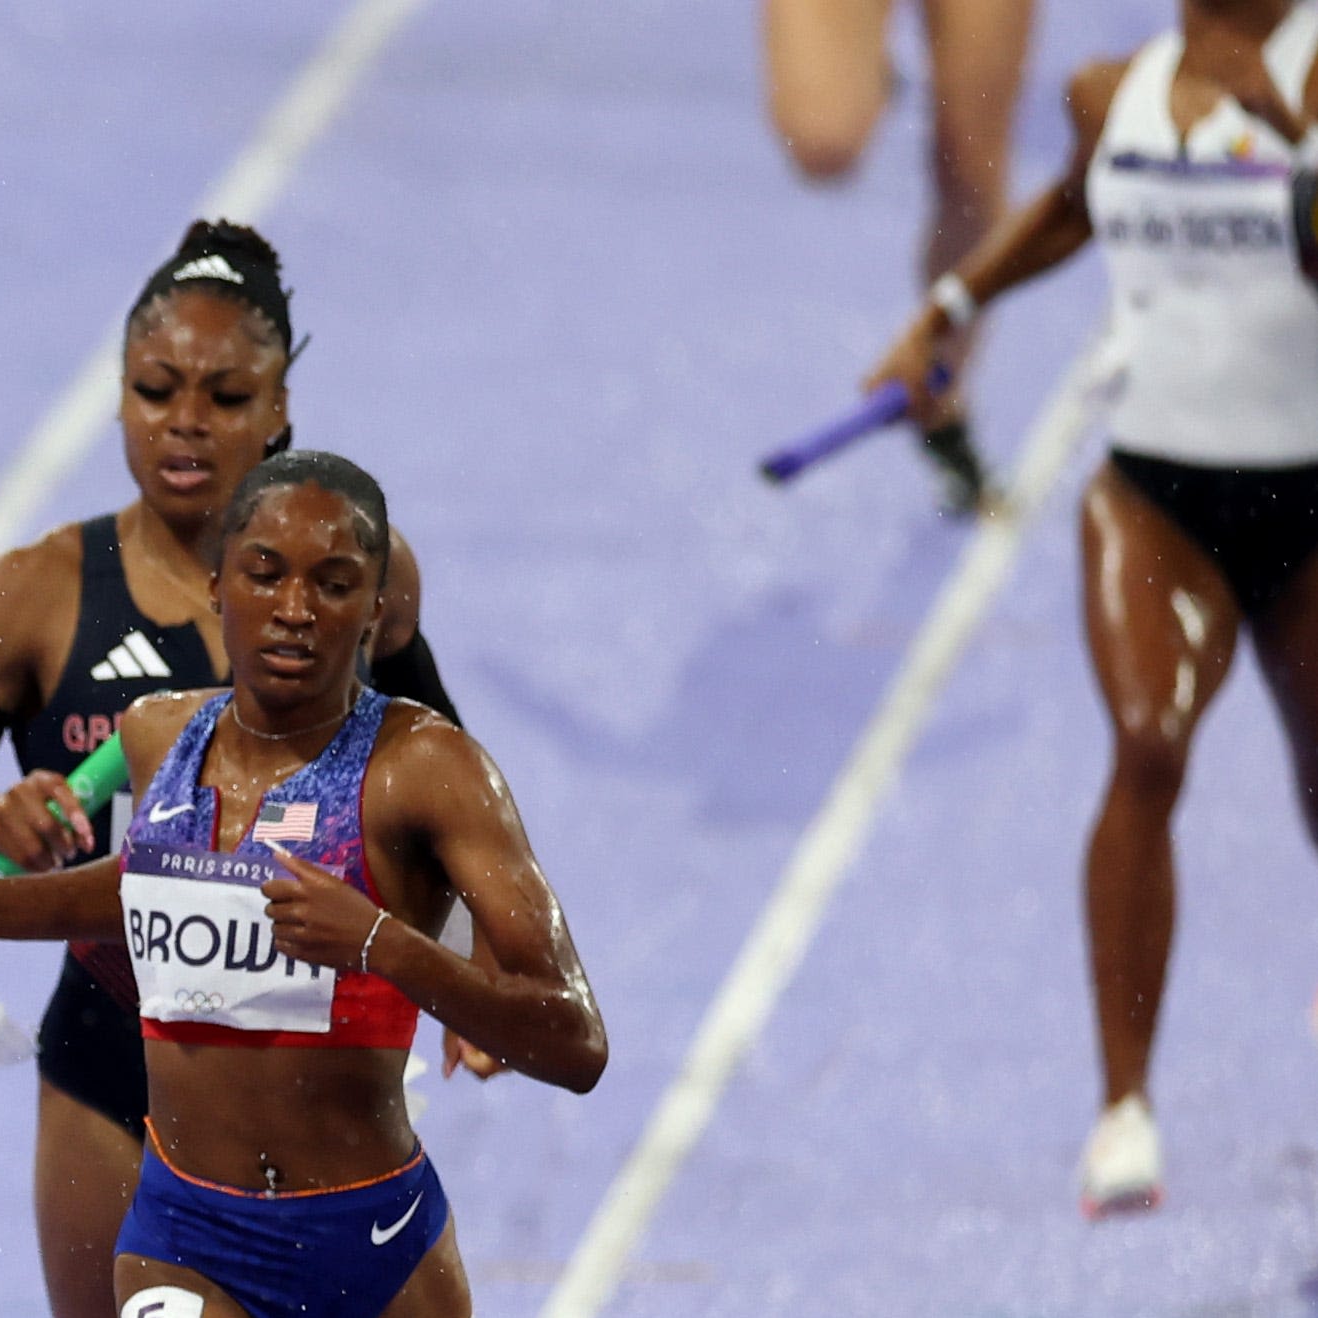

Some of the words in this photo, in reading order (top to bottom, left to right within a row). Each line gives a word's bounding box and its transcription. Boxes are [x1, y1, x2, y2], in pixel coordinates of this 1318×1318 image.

[161, 853, 217, 875] PARIS
[222, 861, 275, 881] 2024
[129, 908, 322, 980] BROW
